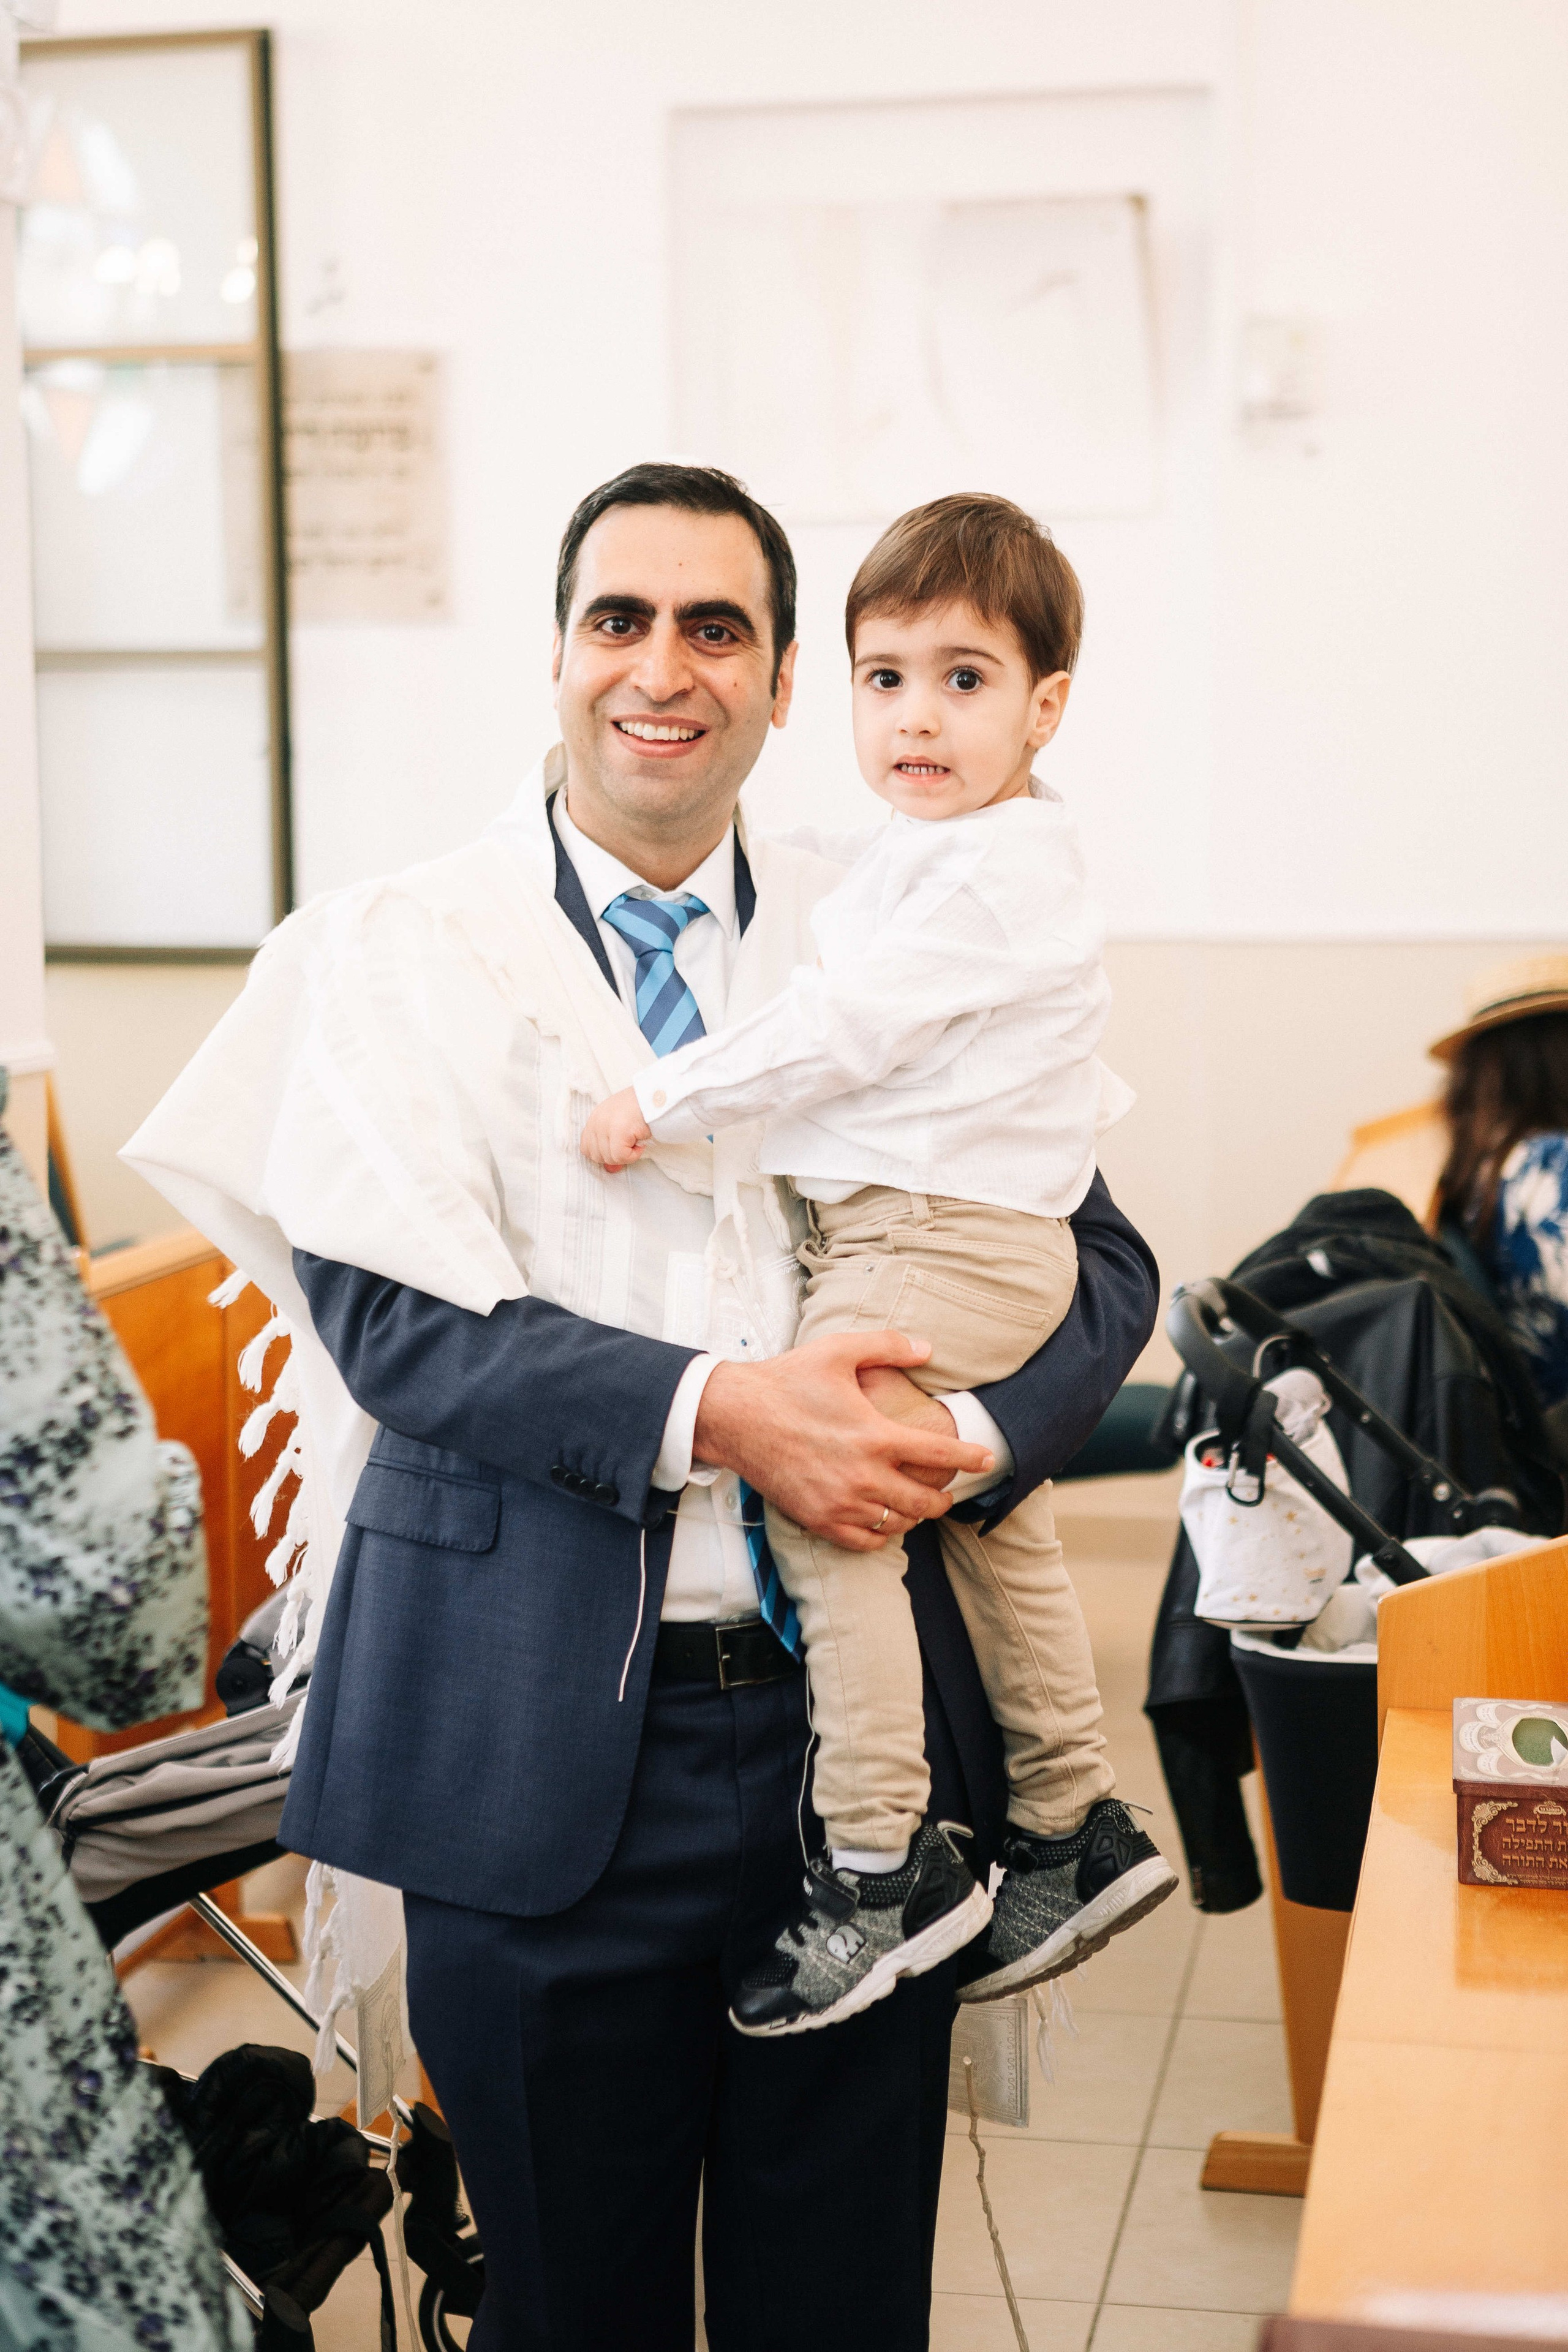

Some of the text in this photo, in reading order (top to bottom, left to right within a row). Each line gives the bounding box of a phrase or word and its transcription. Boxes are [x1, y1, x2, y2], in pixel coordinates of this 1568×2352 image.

[1506, 1814, 1547, 1833] לדבר
[1502, 1834, 1553, 1852] התפילה
[1502, 1854, 1544, 1868] התורה
